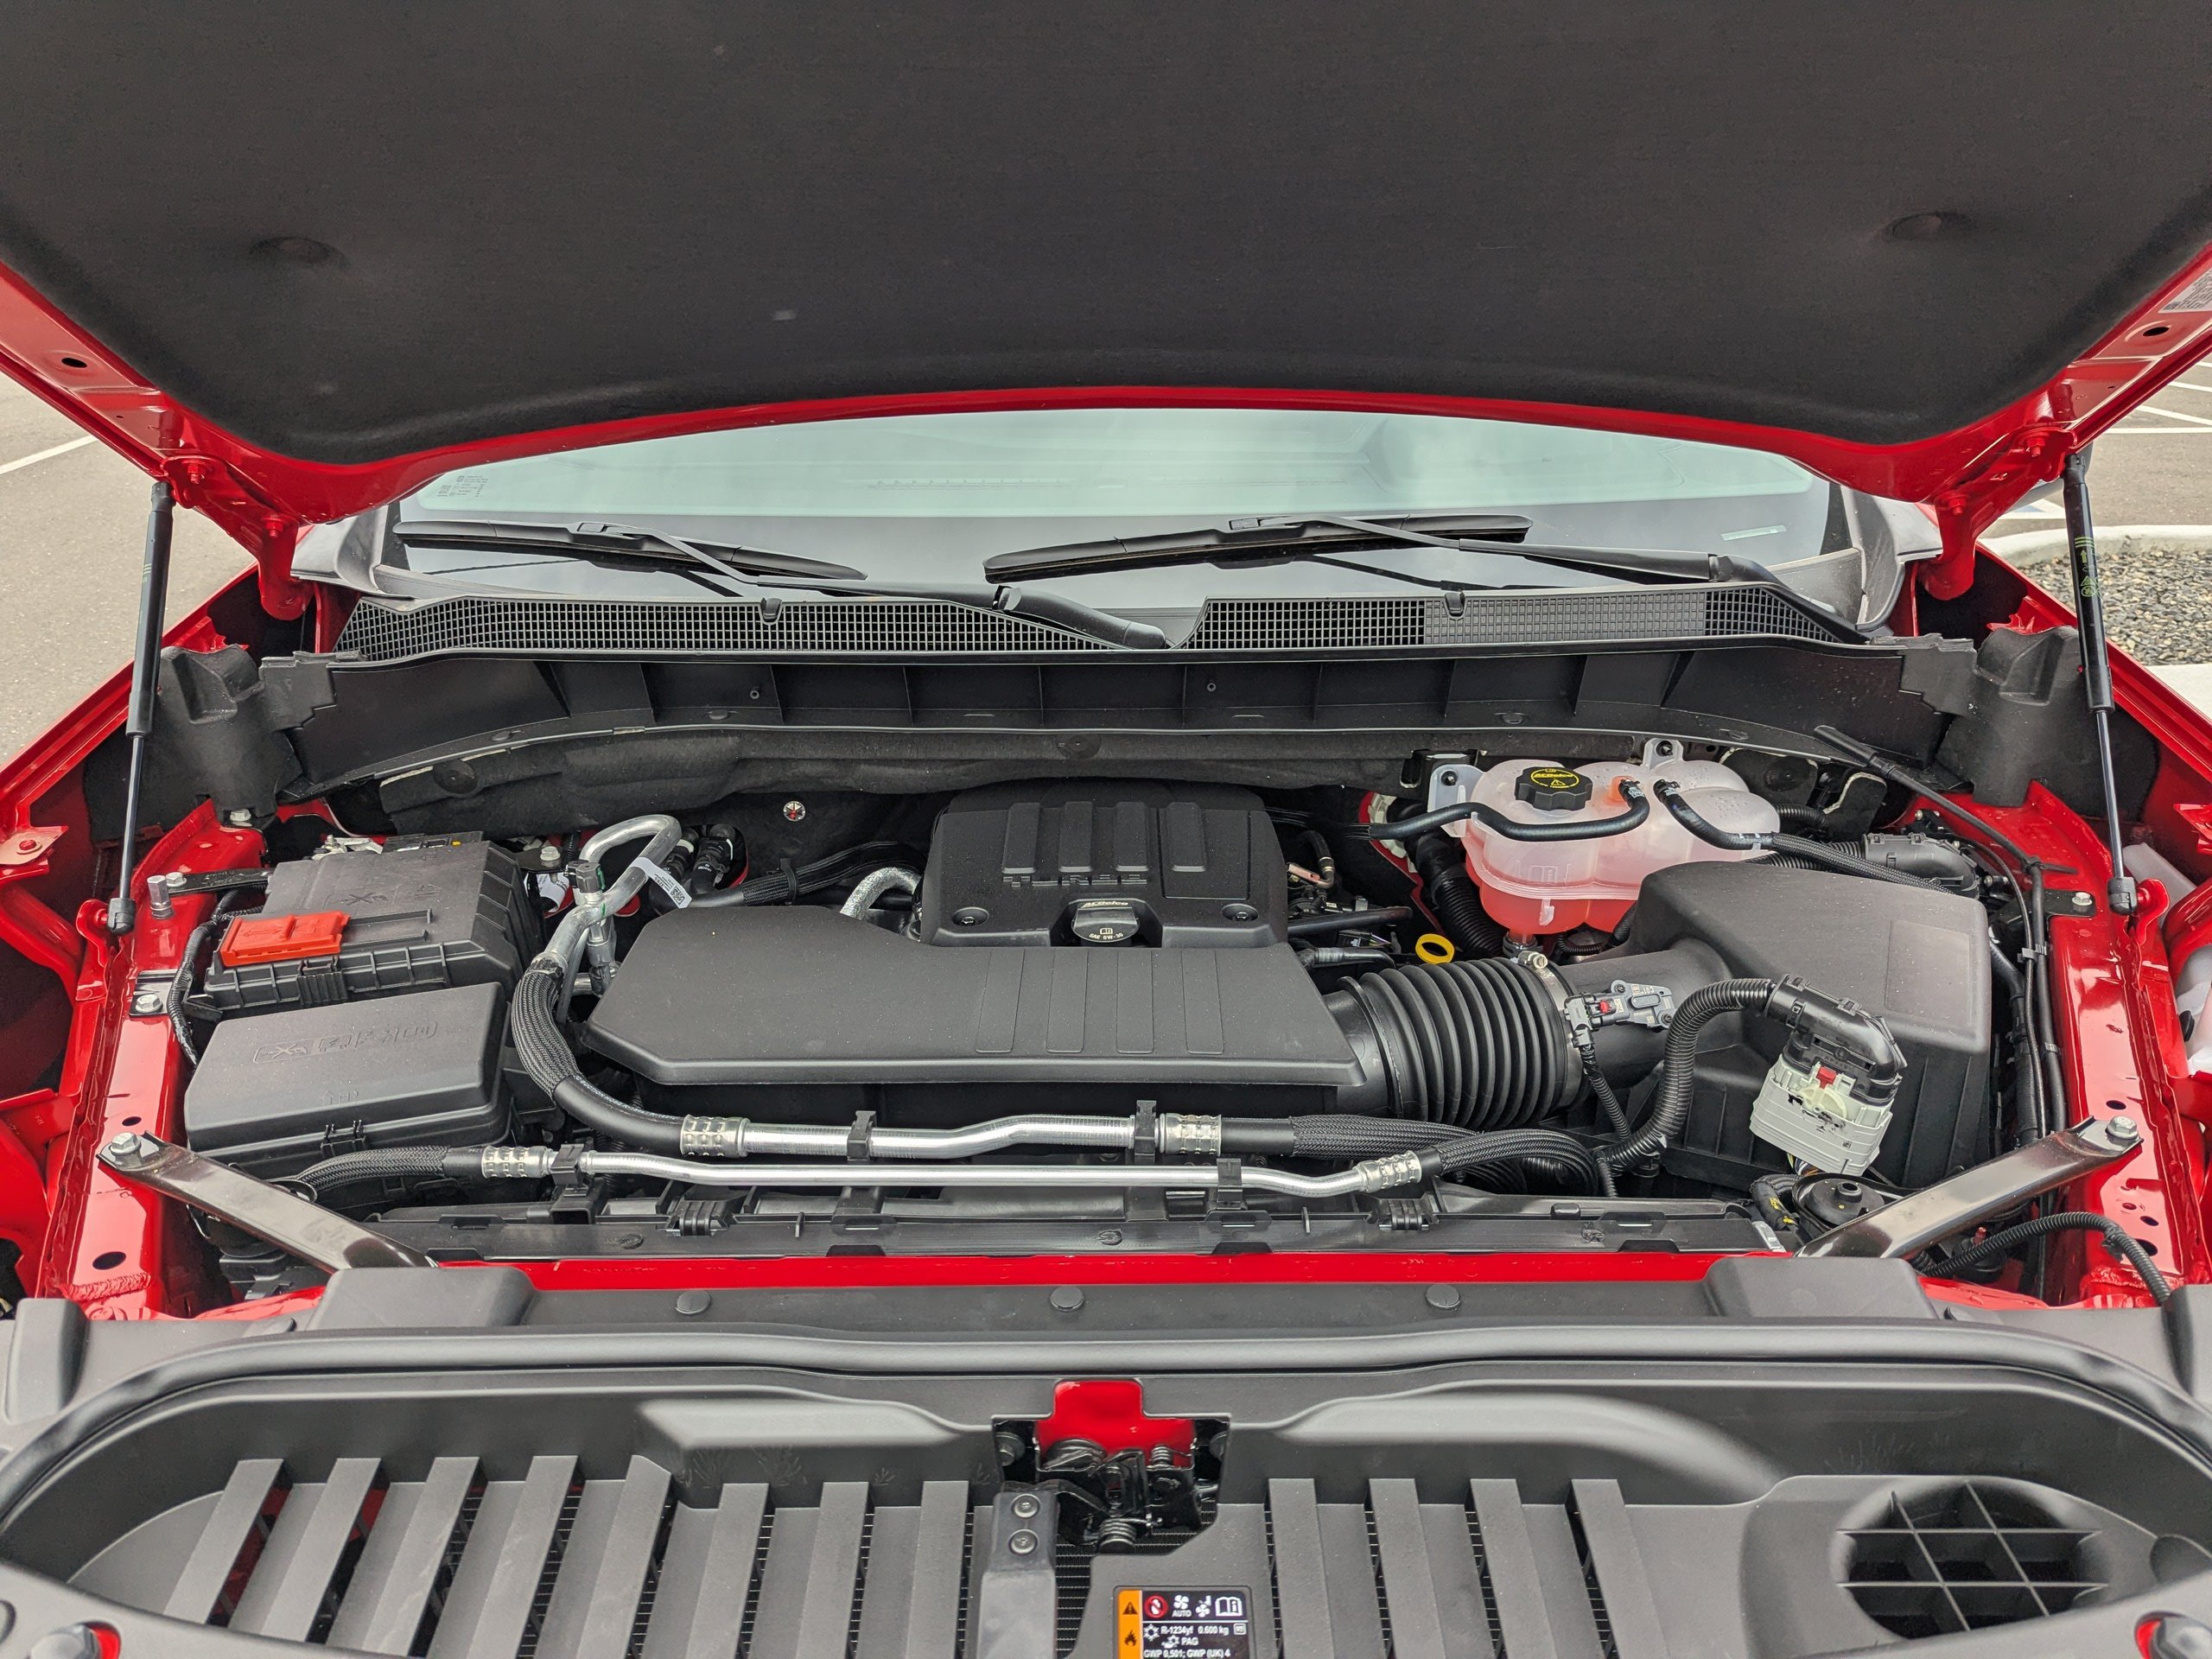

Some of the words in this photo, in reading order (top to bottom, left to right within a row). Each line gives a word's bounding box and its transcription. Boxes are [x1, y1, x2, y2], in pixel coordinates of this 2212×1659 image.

[1160, 1625, 1194, 1636] R-1234yf
[1218, 1625, 1230, 1636] kg
[1180, 1637, 1199, 1646] PAG
[1143, 1649, 1163, 1658] GWP
[1186, 1649, 1206, 1658] GWP
[1206, 1649, 1224, 1659] (UK)
[1224, 1648, 1231, 1658] 4
